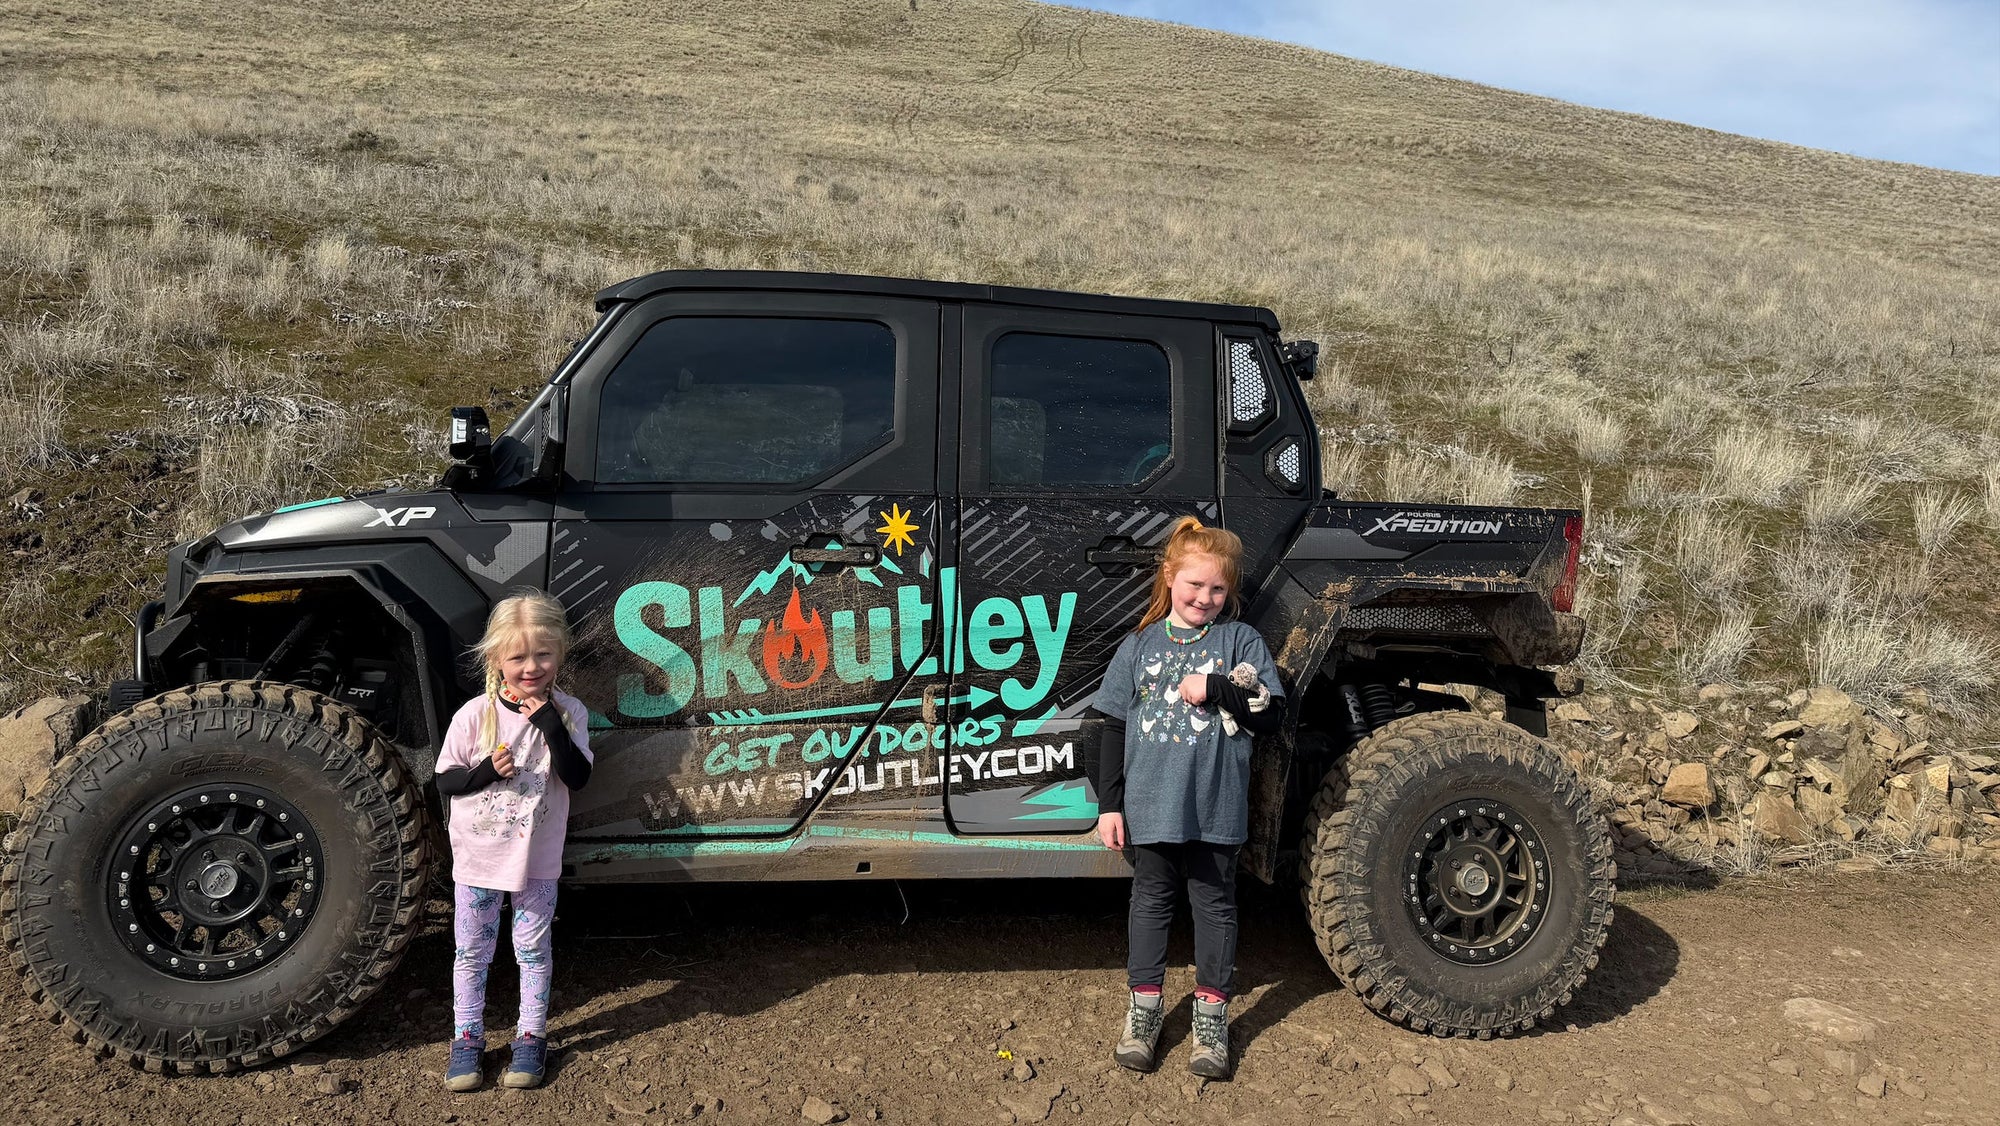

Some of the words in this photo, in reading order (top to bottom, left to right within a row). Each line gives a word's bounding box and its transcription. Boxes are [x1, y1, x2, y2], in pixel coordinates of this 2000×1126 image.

[363, 506, 437, 528] XP
[1361, 511, 1503, 537] XPEDITION
[1406, 511, 1442, 519] POLARIS
[347, 687, 376, 699] DRT
[1344, 690, 1366, 724] FOX
[703, 733, 794, 776] GET
